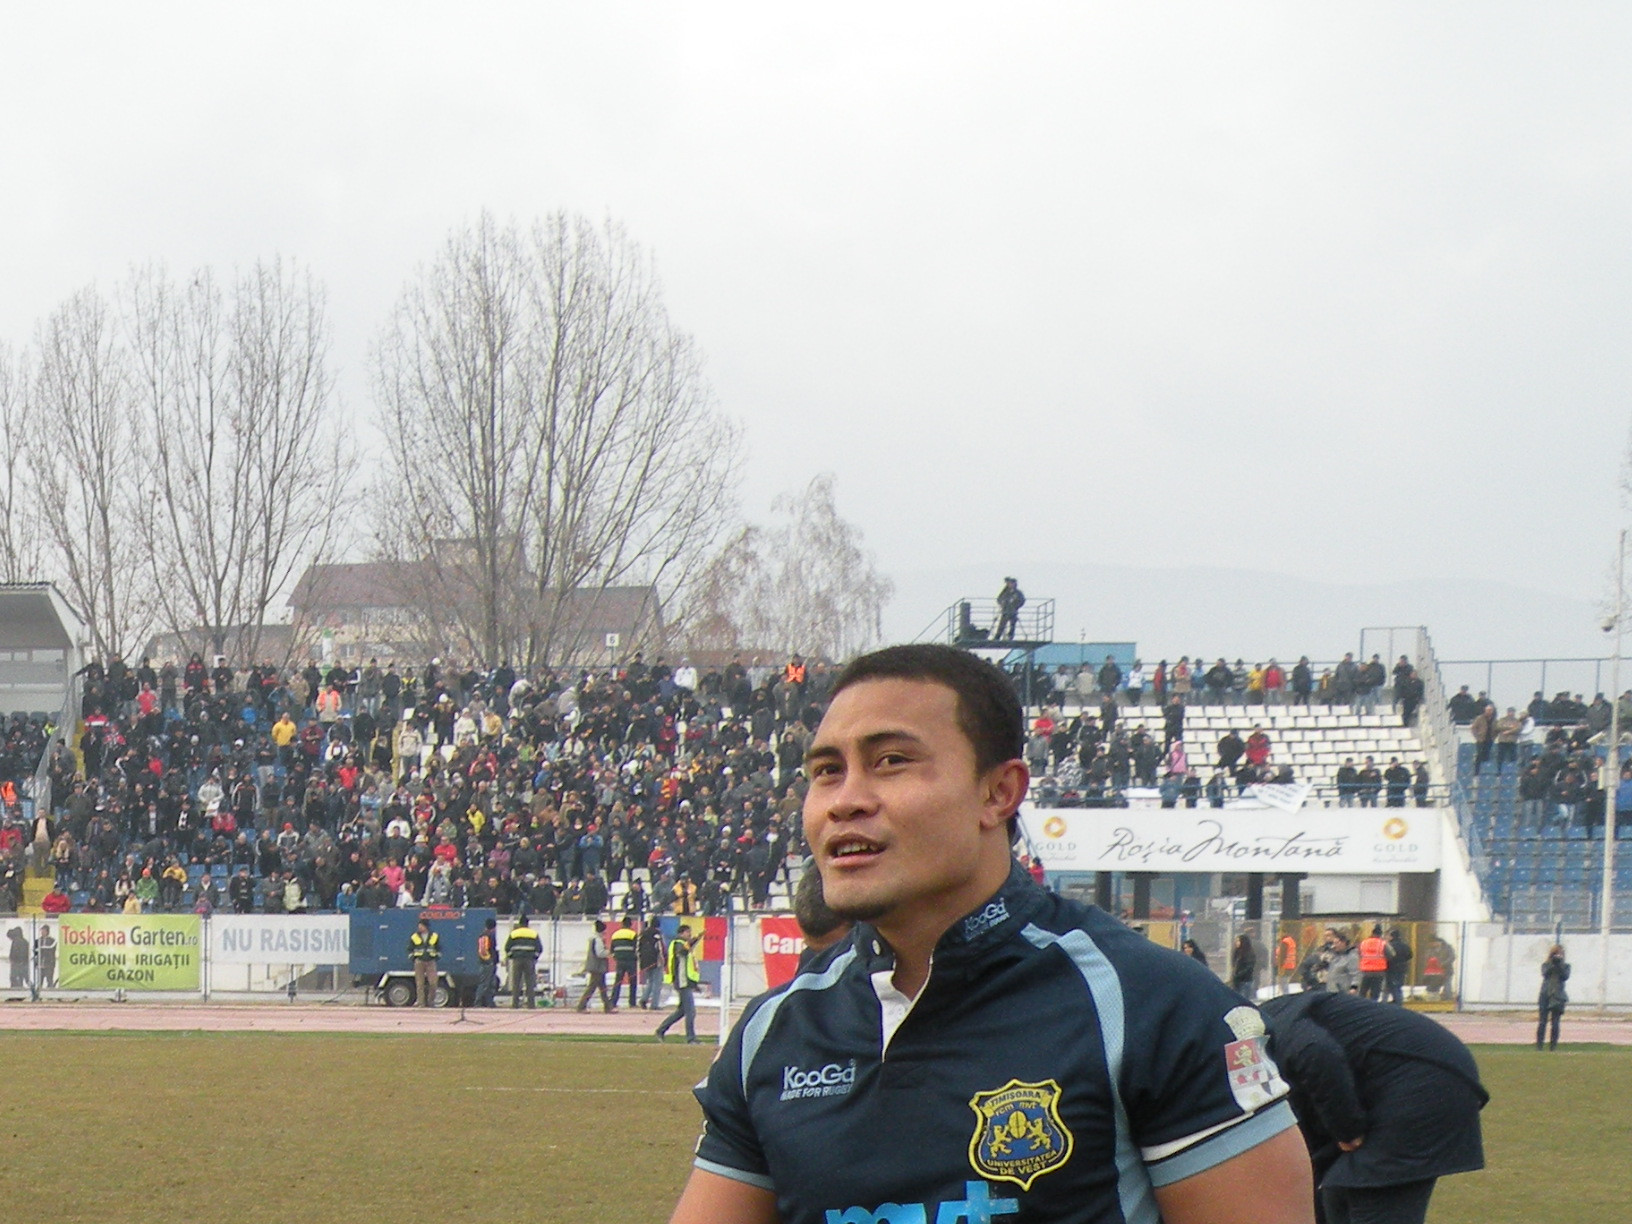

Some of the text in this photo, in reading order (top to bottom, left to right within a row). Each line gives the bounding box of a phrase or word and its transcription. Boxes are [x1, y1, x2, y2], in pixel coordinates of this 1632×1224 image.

[1035, 841, 1077, 851] GOLD
[1373, 843, 1419, 853] GOLD
[61, 925, 125, 945] Toskana
[222, 928, 252, 951] NU
[106, 969, 154, 981] GAZON
[783, 1063, 856, 1091] KooGa
[991, 1091, 1041, 1107] TIMISOARA
[987, 1150, 1058, 1167] UNIVERSITATEA
[1000, 1161, 1047, 1175] DE VEST
